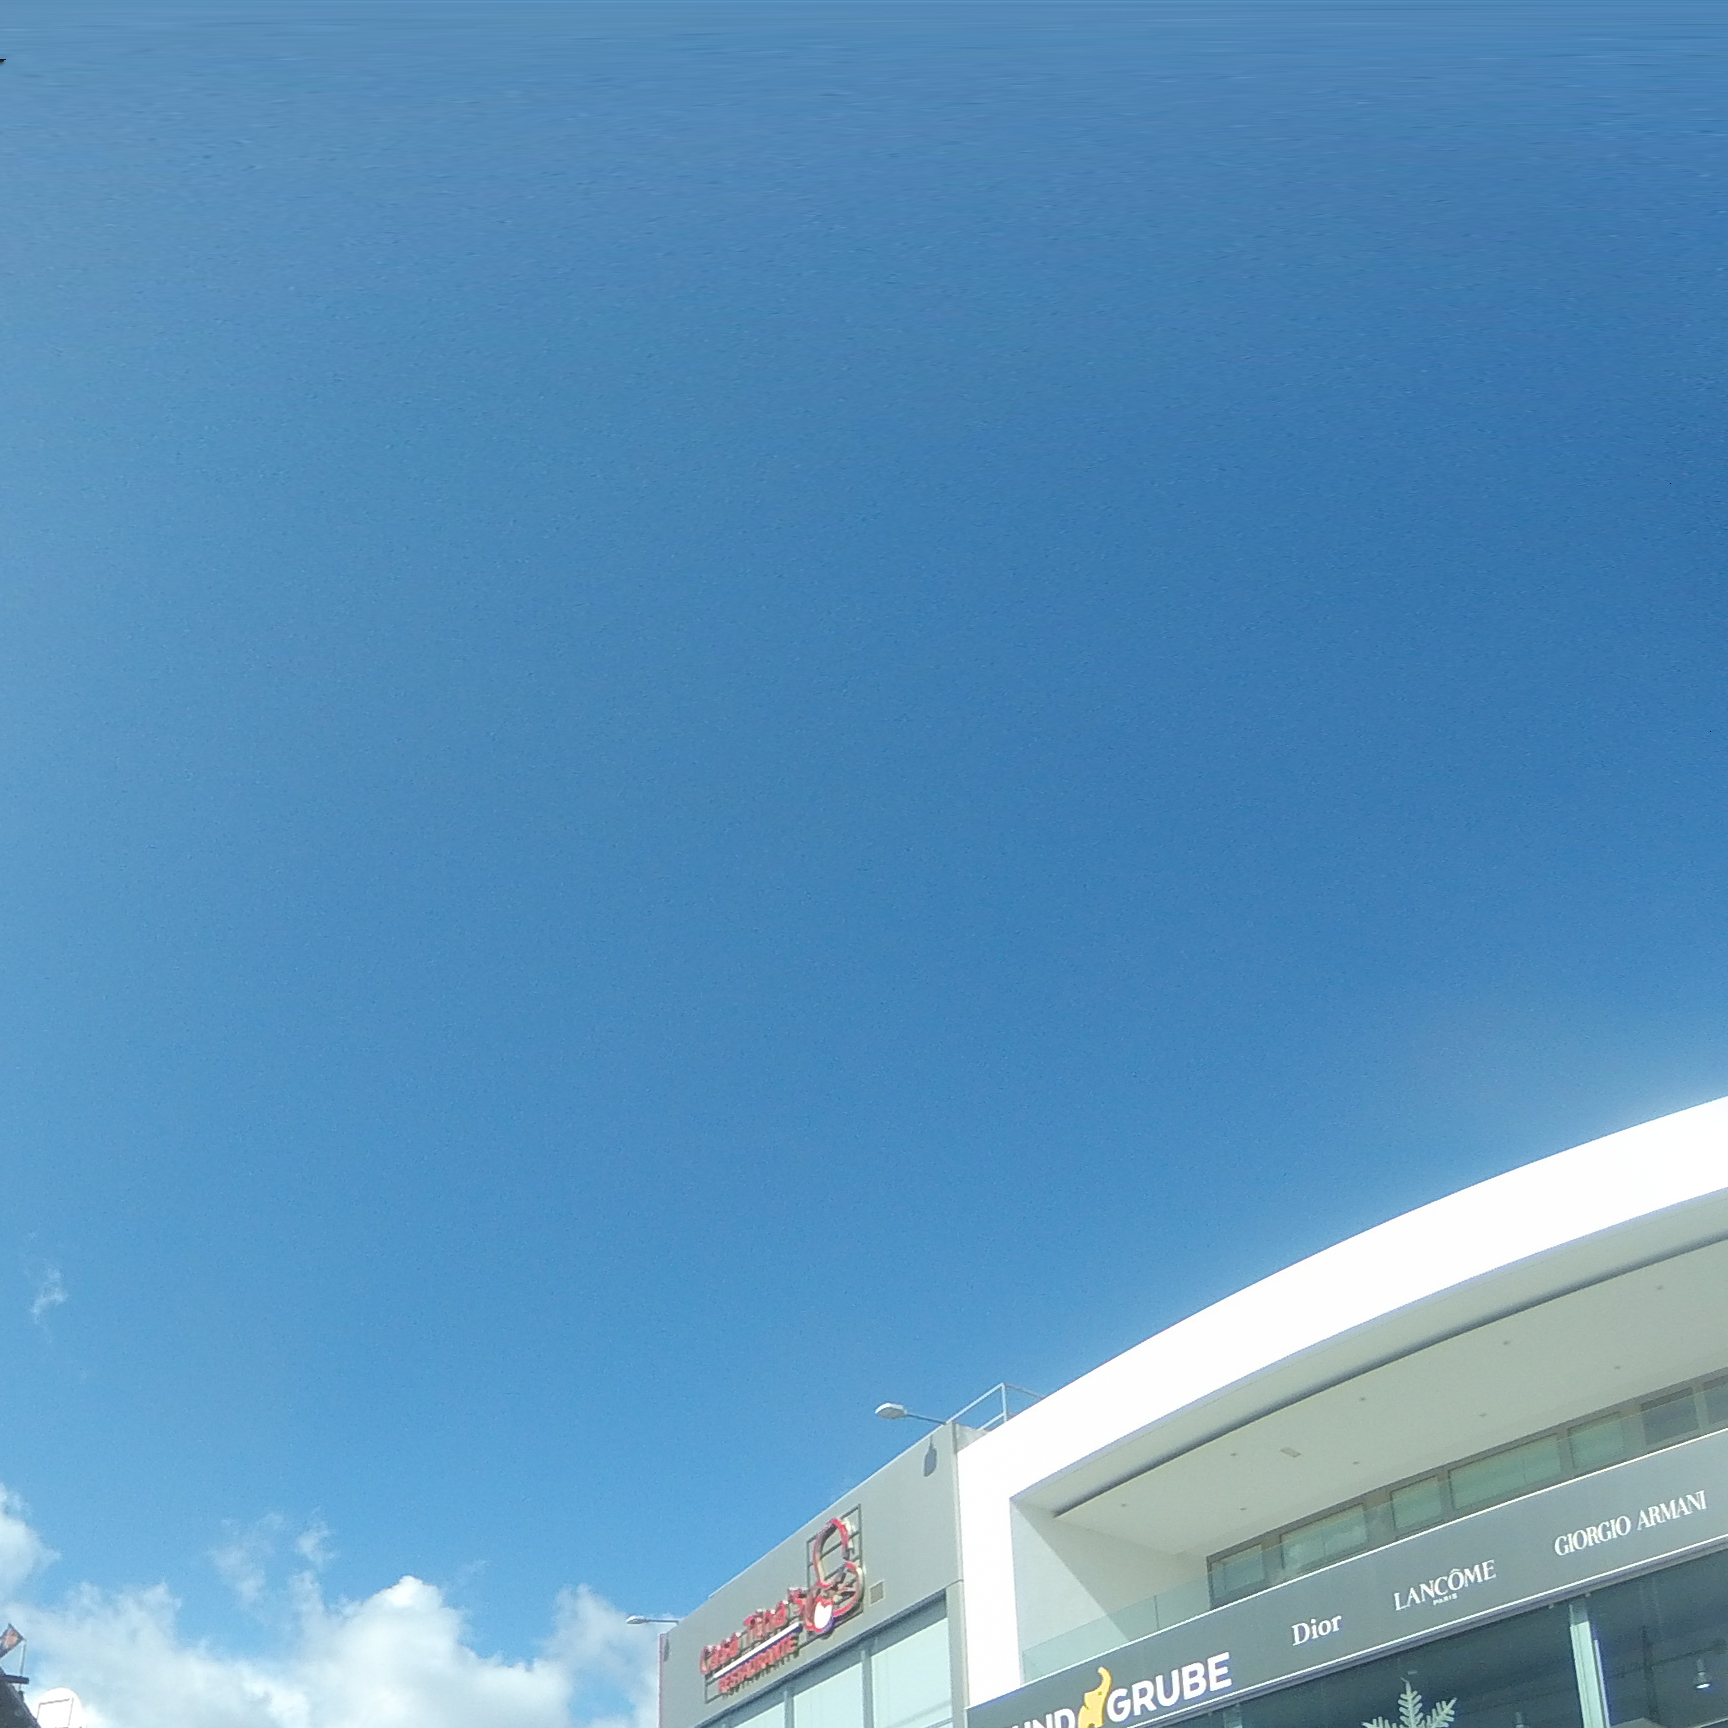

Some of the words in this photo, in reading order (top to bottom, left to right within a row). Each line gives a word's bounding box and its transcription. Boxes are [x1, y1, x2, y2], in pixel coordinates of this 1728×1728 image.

[1554, 1515, 1632, 1556] GIORGIO
[1636, 1490, 1707, 1531] ARMANI
[1394, 1559, 1497, 1611] LANCÔME
[1291, 1615, 1342, 1646] Dior
[1106, 1652, 1233, 1723] GRUBE
